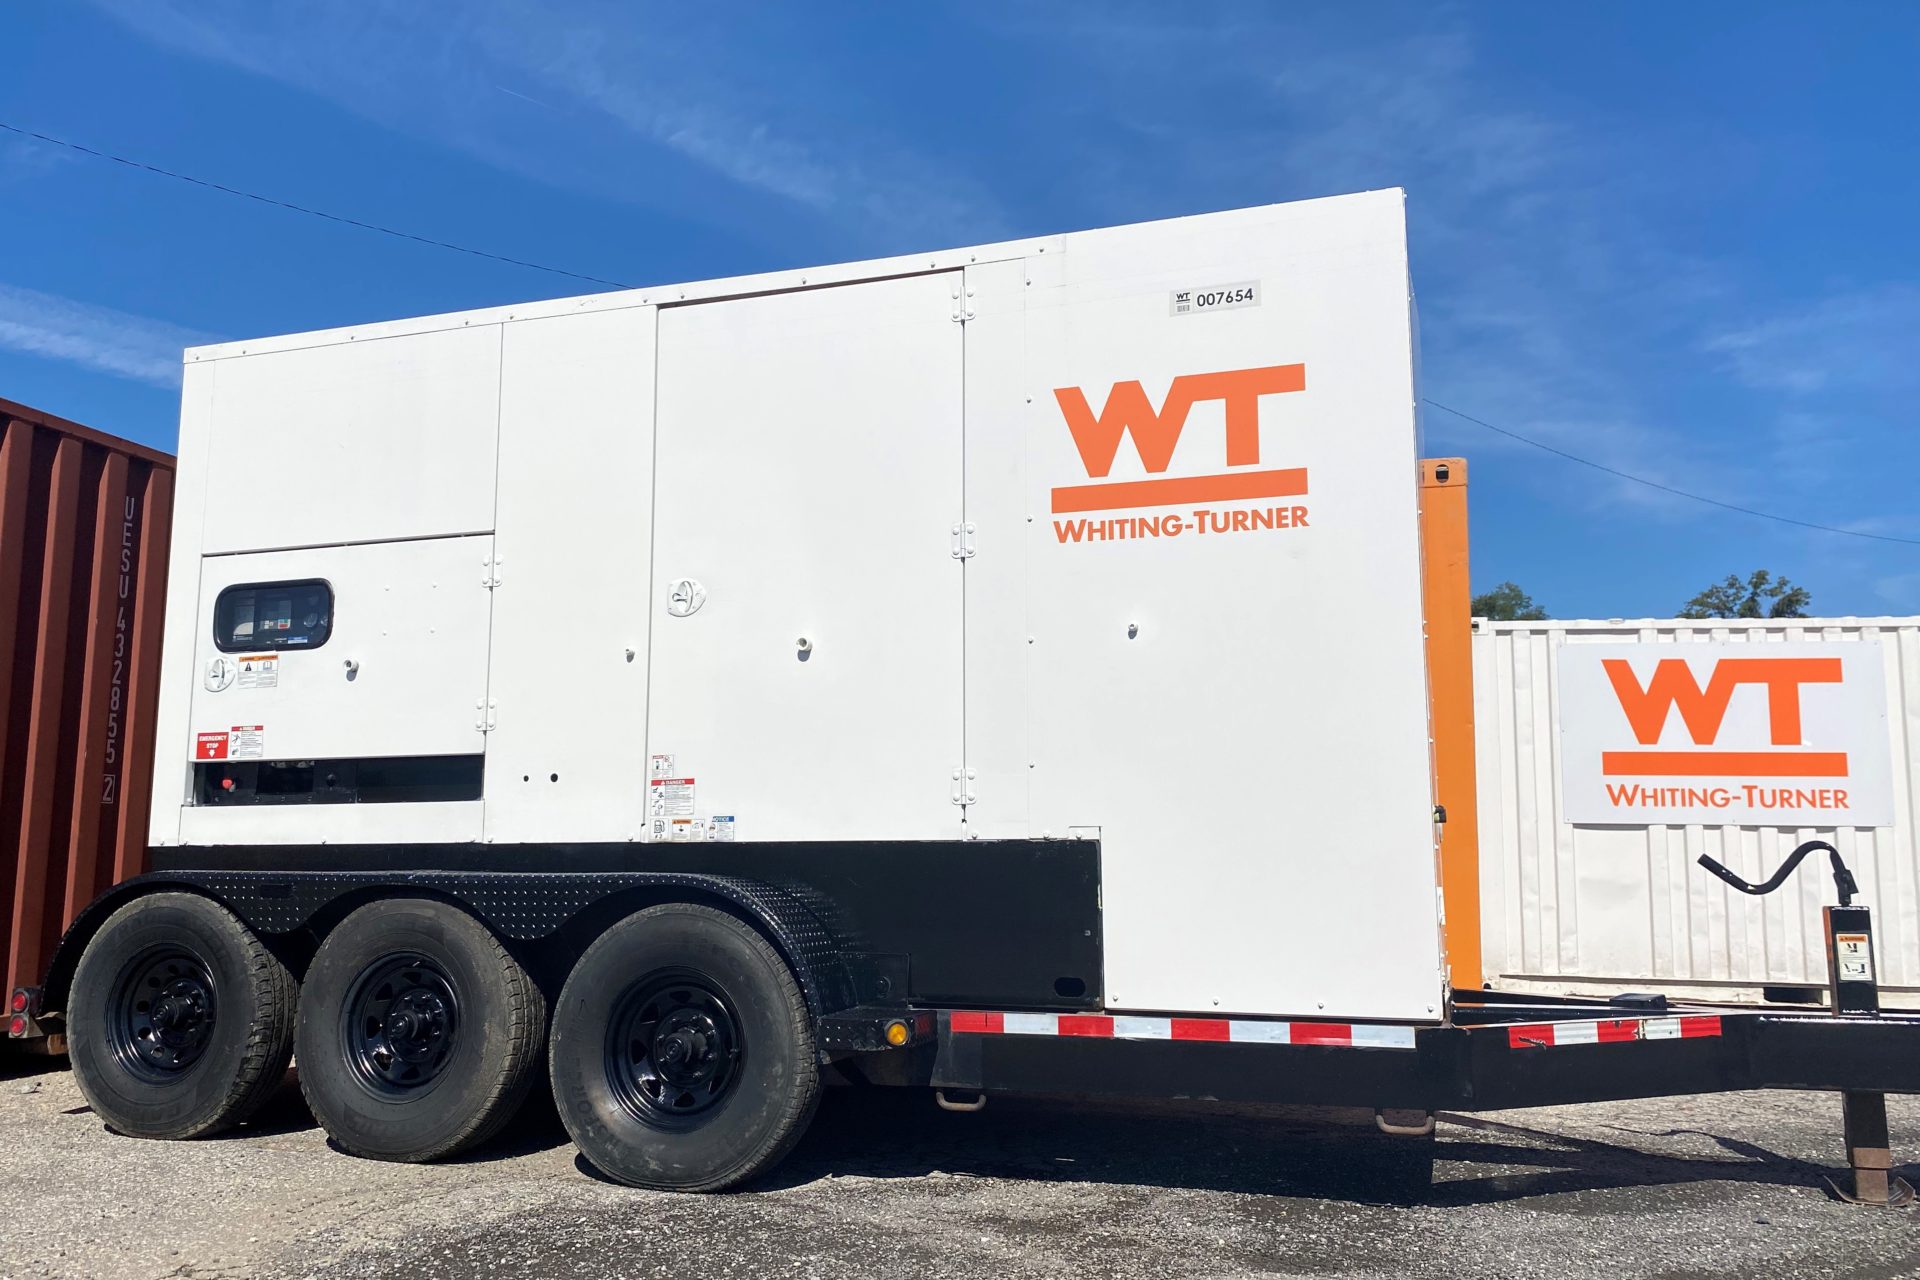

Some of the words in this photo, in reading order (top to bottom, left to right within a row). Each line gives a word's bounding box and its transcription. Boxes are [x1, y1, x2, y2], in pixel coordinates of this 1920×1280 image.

[1176, 292, 1191, 300] WT
[1197, 288, 1254, 307] 007654
[1053, 363, 1306, 478] WT
[119, 496, 135, 599] UESU
[1053, 506, 1310, 544] WHITING-TURNER
[106, 607, 125, 764] 432855
[1601, 658, 1843, 745] WT
[102, 776, 113, 802] 2
[1605, 784, 1850, 809] WHITING-TURNER
